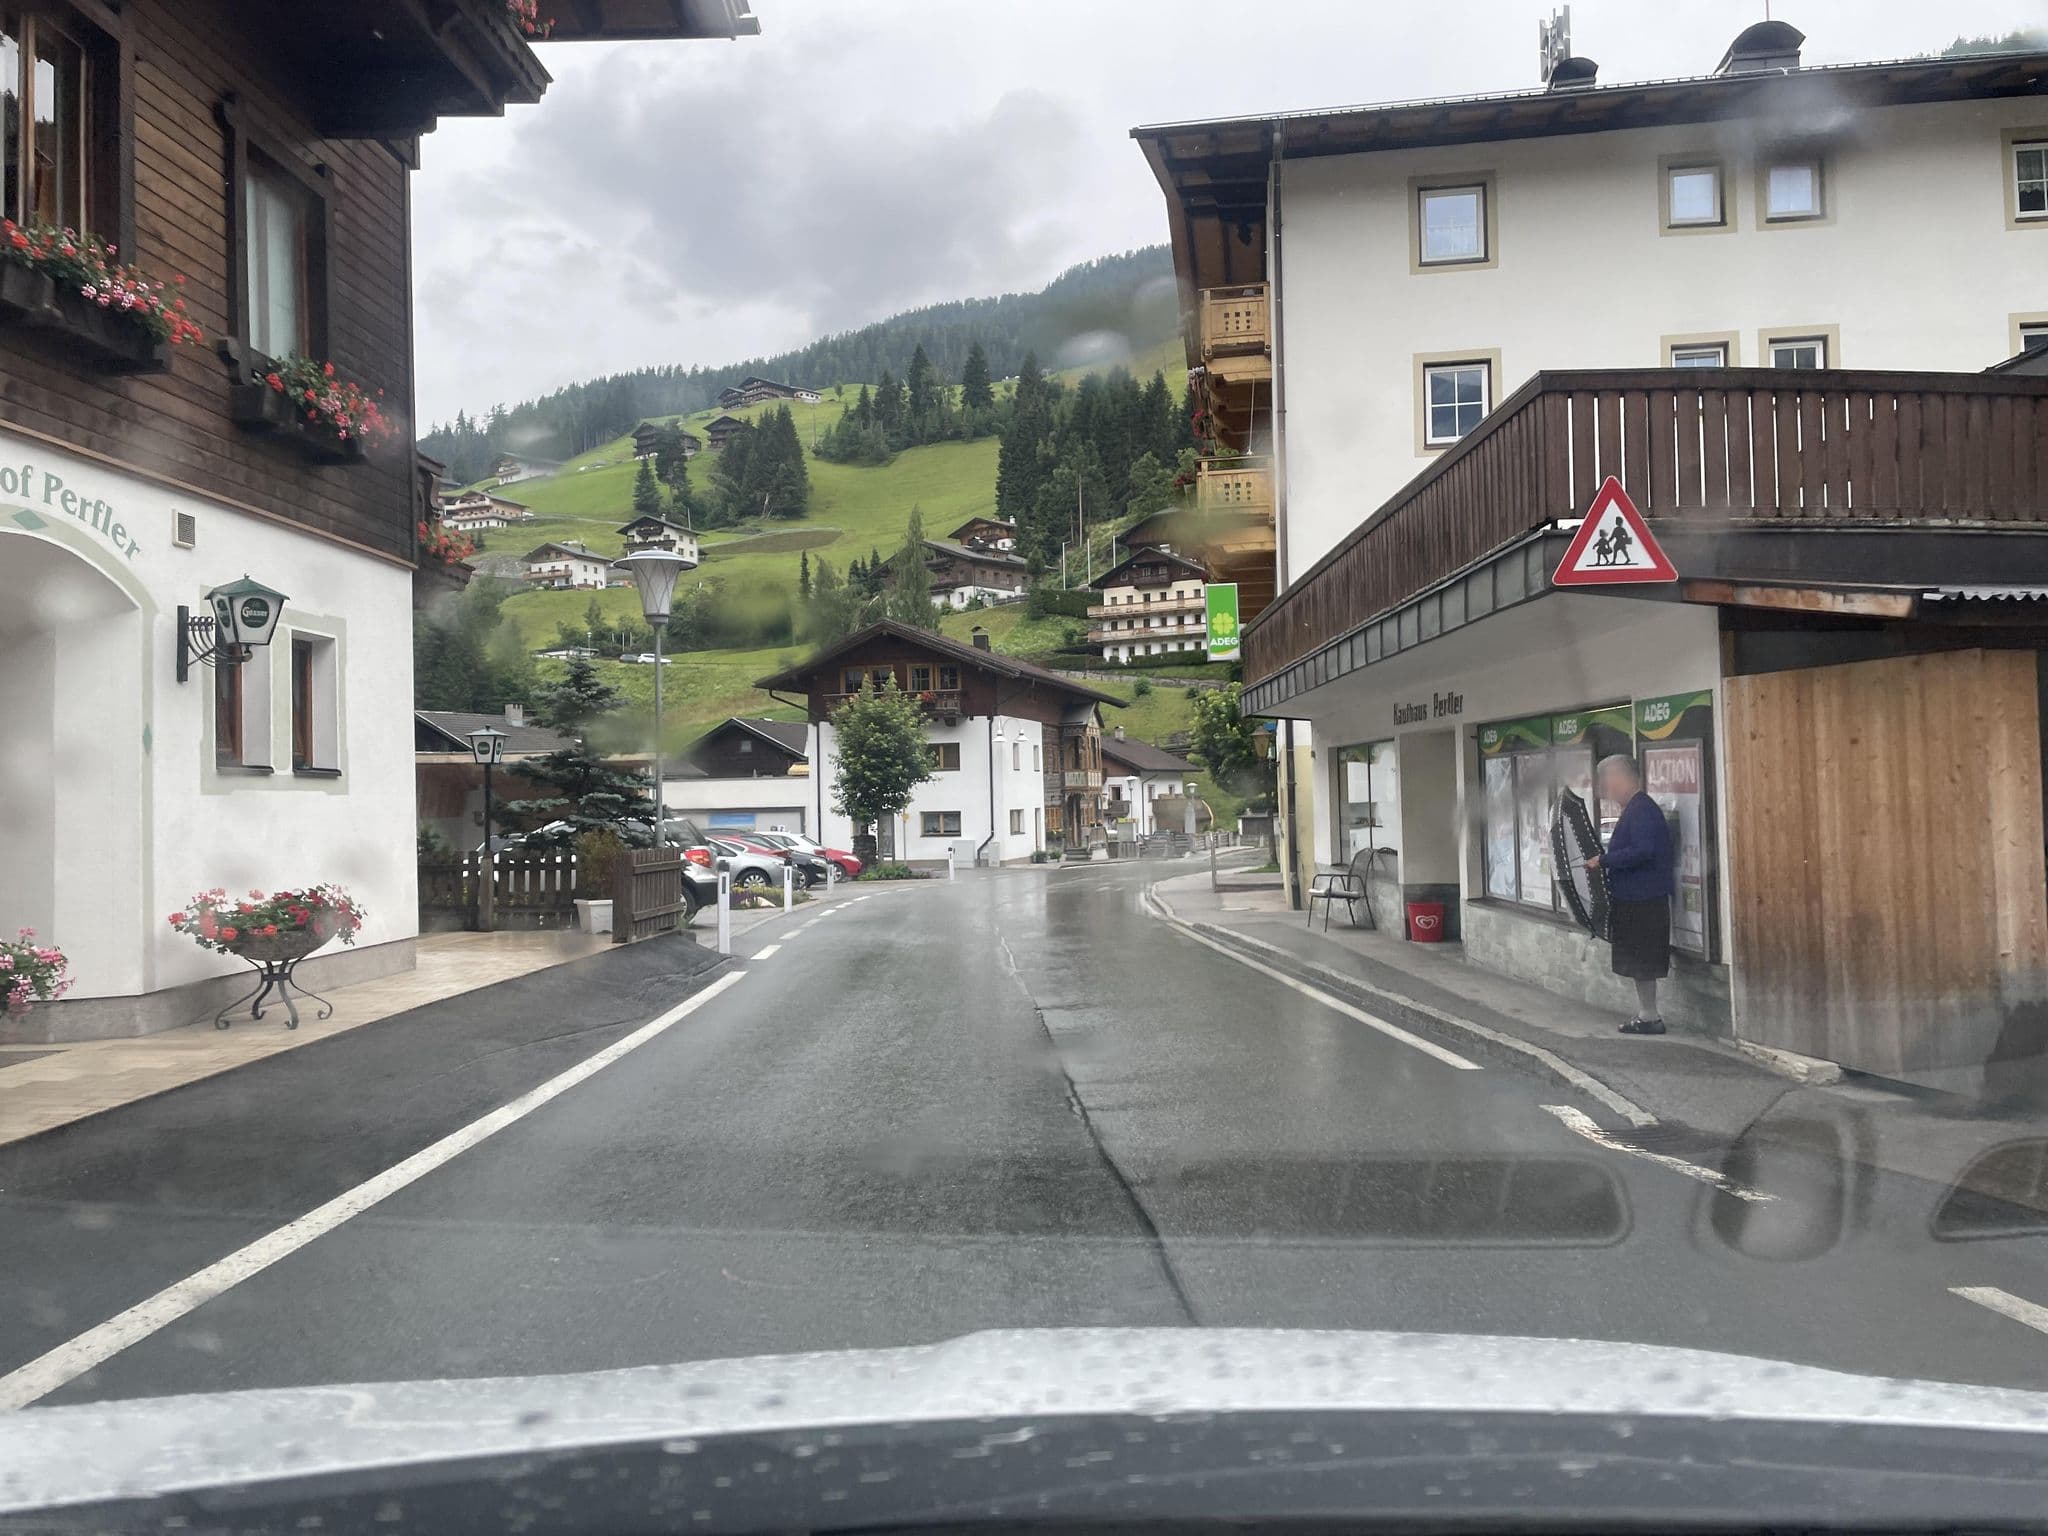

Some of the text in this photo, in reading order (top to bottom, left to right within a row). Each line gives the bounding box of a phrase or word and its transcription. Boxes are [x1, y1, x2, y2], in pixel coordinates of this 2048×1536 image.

[43, 472, 141, 560] Perfler
[1210, 637, 1239, 646] ADEG
[1644, 702, 1670, 722] ADEG
[1558, 718, 1578, 735] ADEG
[1484, 730, 1498, 744] ADEG
[1648, 758, 1697, 785] AKTION
